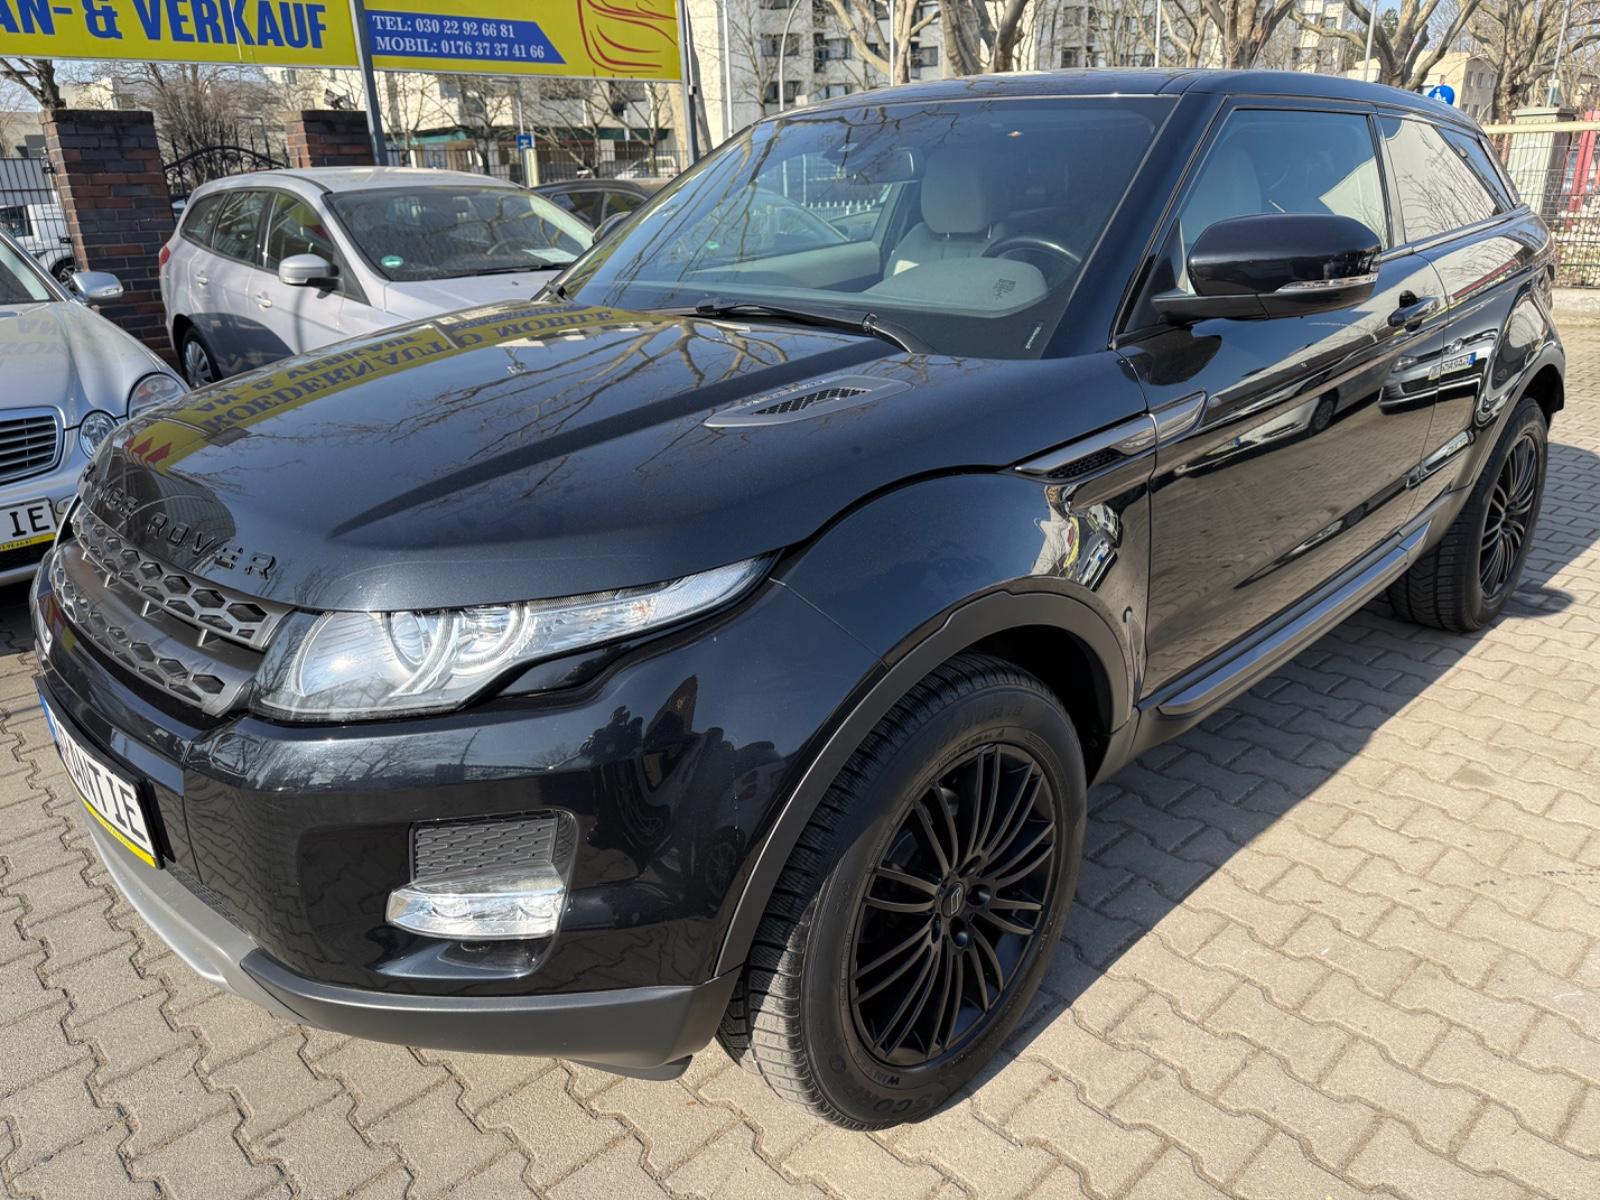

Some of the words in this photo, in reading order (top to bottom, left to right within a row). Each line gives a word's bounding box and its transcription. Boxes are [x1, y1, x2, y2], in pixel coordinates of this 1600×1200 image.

[84, 0, 123, 39] &
[132, 0, 327, 49] VERKAUF
[372, 15, 412, 32] TEL:
[415, 18, 440, 34] 030
[443, 20, 460, 35] 22
[463, 22, 480, 36] 92
[482, 23, 497, 37] 66
[500, 25, 516, 38] 81
[375, 36, 438, 53] MOBIL:
[440, 41, 473, 54] 0176
[475, 42, 491, 56] 37
[493, 43, 509, 57] 37
[511, 44, 527, 58] 41
[530, 45, 545, 58] 66
[147, 511, 277, 580] ROVER
